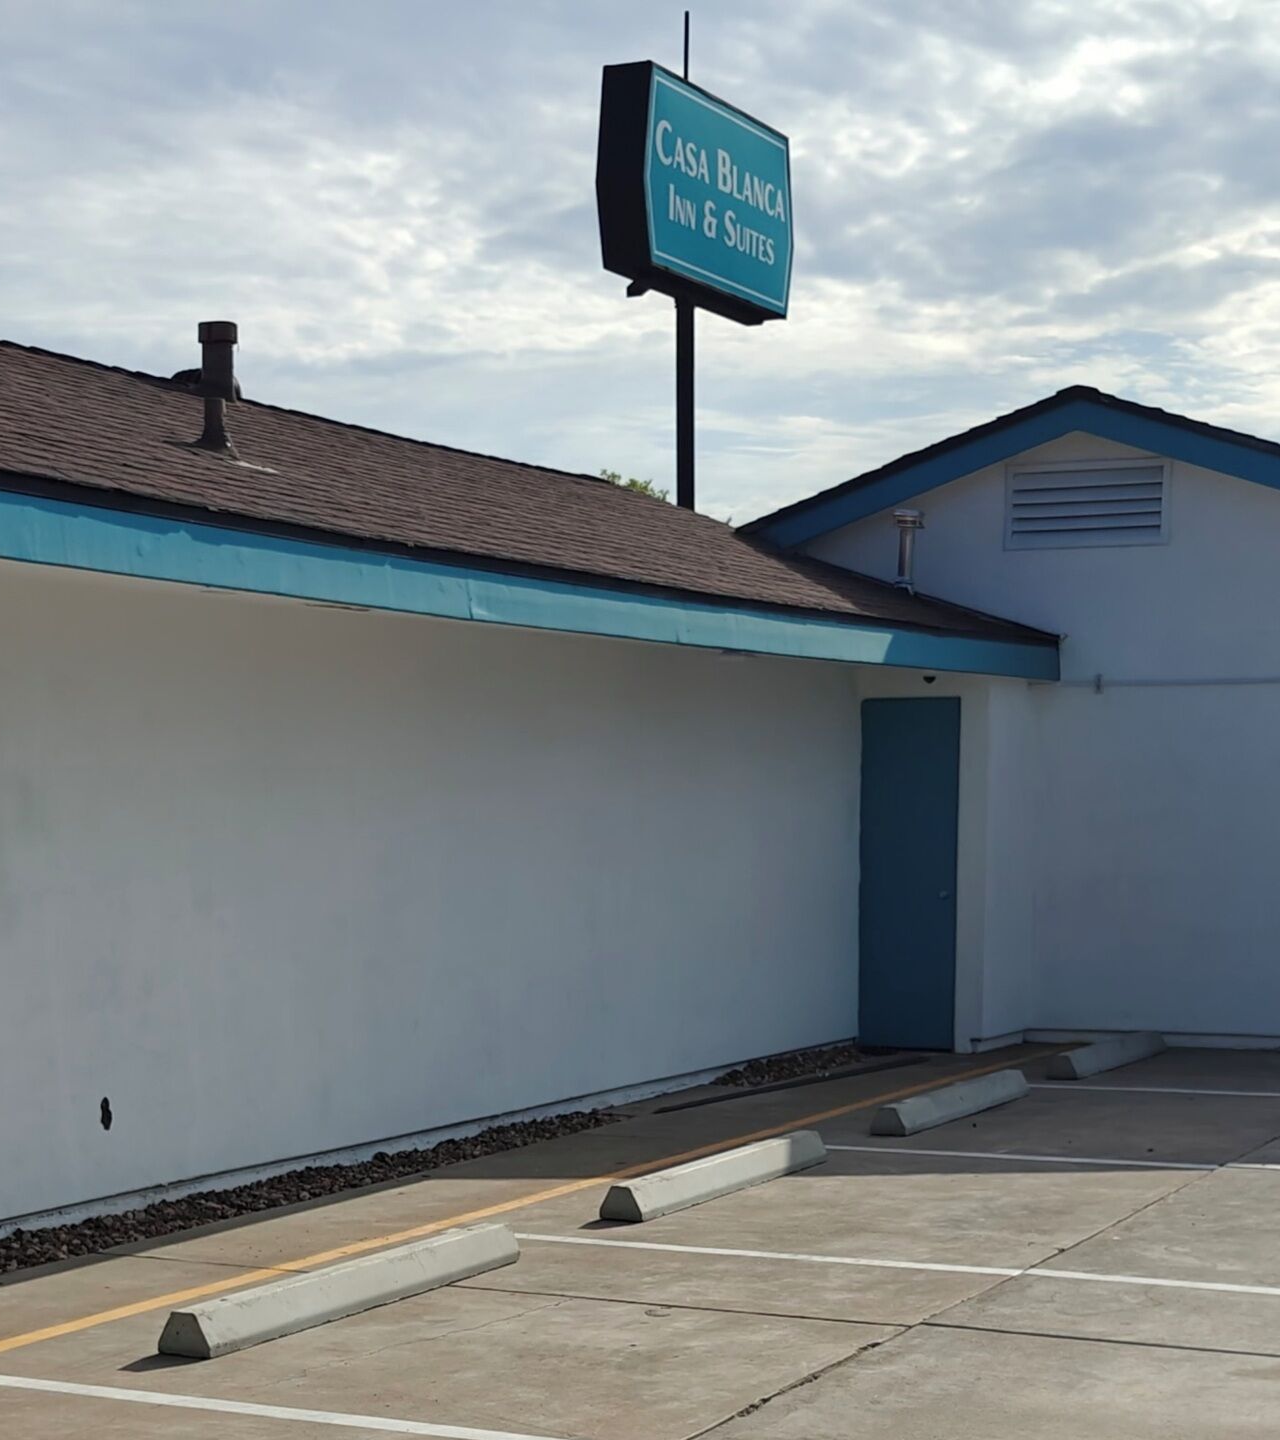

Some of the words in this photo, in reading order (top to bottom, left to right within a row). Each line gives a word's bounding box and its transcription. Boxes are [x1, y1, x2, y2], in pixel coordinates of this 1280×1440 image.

[655, 119, 710, 185] CASA
[717, 148, 786, 223] BLANCA
[668, 184, 697, 231] INN
[703, 200, 717, 239] &
[723, 210, 775, 265] SUITES
